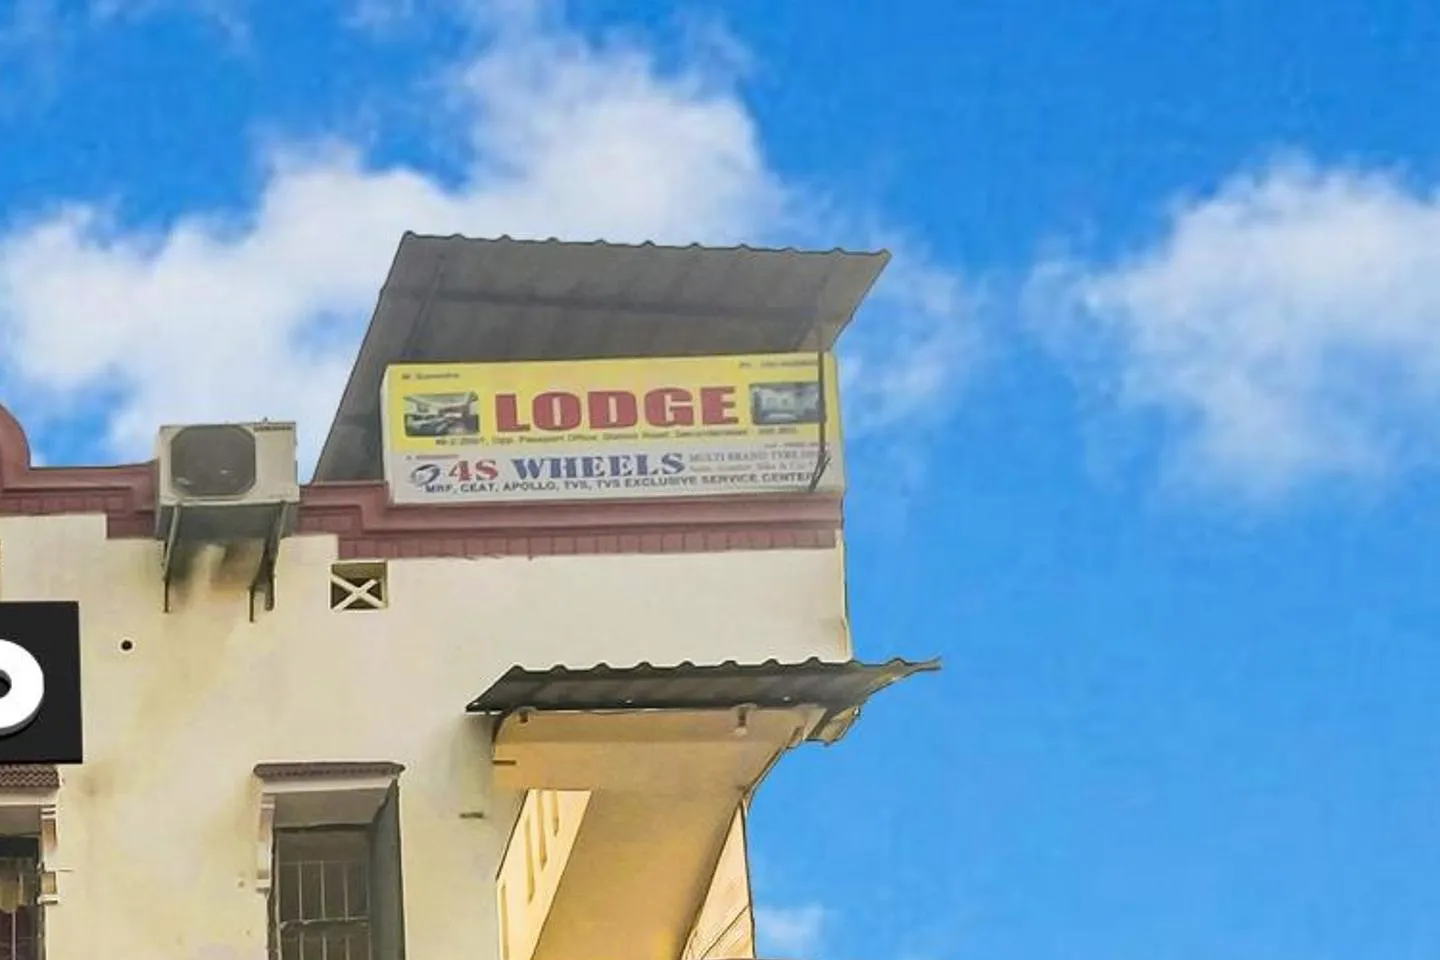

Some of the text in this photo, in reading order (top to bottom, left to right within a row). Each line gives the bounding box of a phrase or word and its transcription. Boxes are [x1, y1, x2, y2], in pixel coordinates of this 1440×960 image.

[495, 386, 739, 432] LODGE
[449, 458, 498, 481] 4S
[511, 453, 685, 481] WHEELS
[625, 474, 699, 488] EXCLUSIVE
[702, 472, 758, 484] SERVICE
